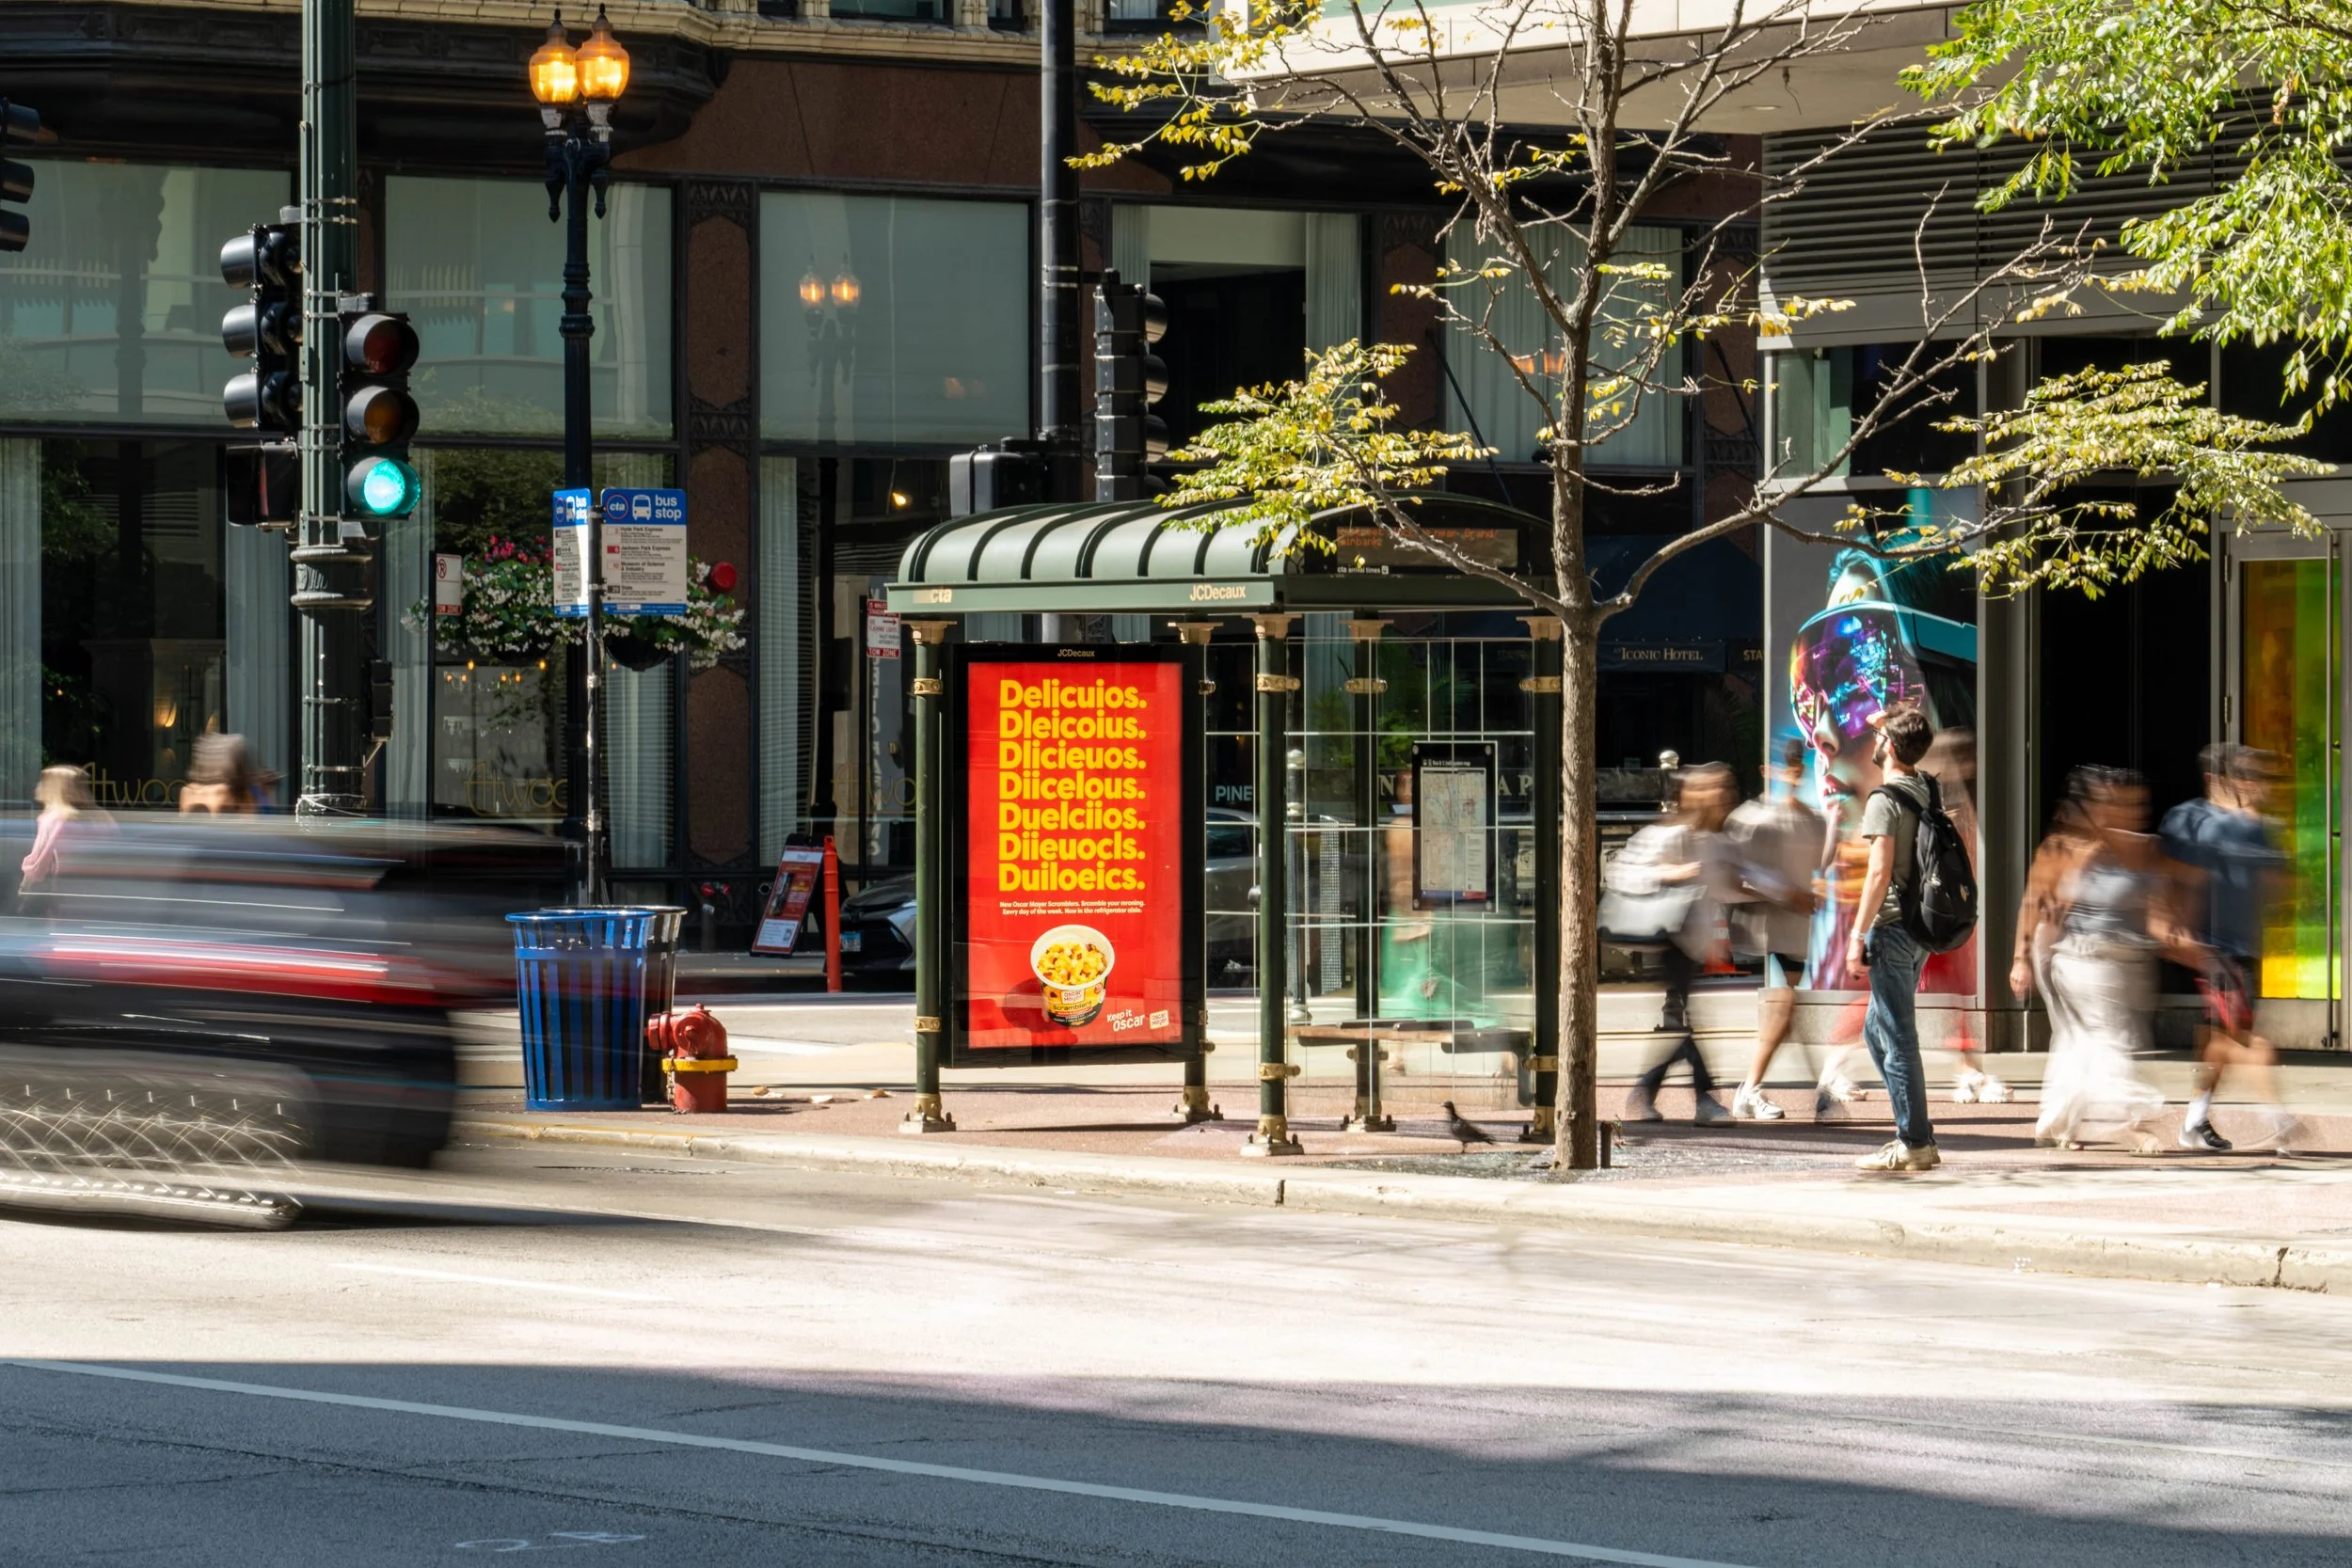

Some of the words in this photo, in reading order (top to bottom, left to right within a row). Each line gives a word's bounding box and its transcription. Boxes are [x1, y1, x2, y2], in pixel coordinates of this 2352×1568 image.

[610, 502, 625, 512] cta
[655, 495, 677, 507] bus
[655, 508, 682, 521] stop
[1189, 584, 1247, 602] JCDecaux
[1057, 648, 1095, 658] JCDecaux
[999, 678, 1147, 709] Delicuios.
[999, 708, 1147, 739] Dleicoius.
[999, 739, 1147, 769] Dlicieuos.
[463, 761, 567, 817] Atwoo
[999, 769, 1146, 800] Diicelous.
[999, 800, 1146, 831] Duelciios.
[999, 831, 1146, 861] Diieuocls.
[999, 861, 1146, 892] Duiloeics.
[1053, 1000, 1092, 1011] Scramblers
[1106, 1011, 1125, 1022] Keep
[1125, 1008, 1133, 1017] it
